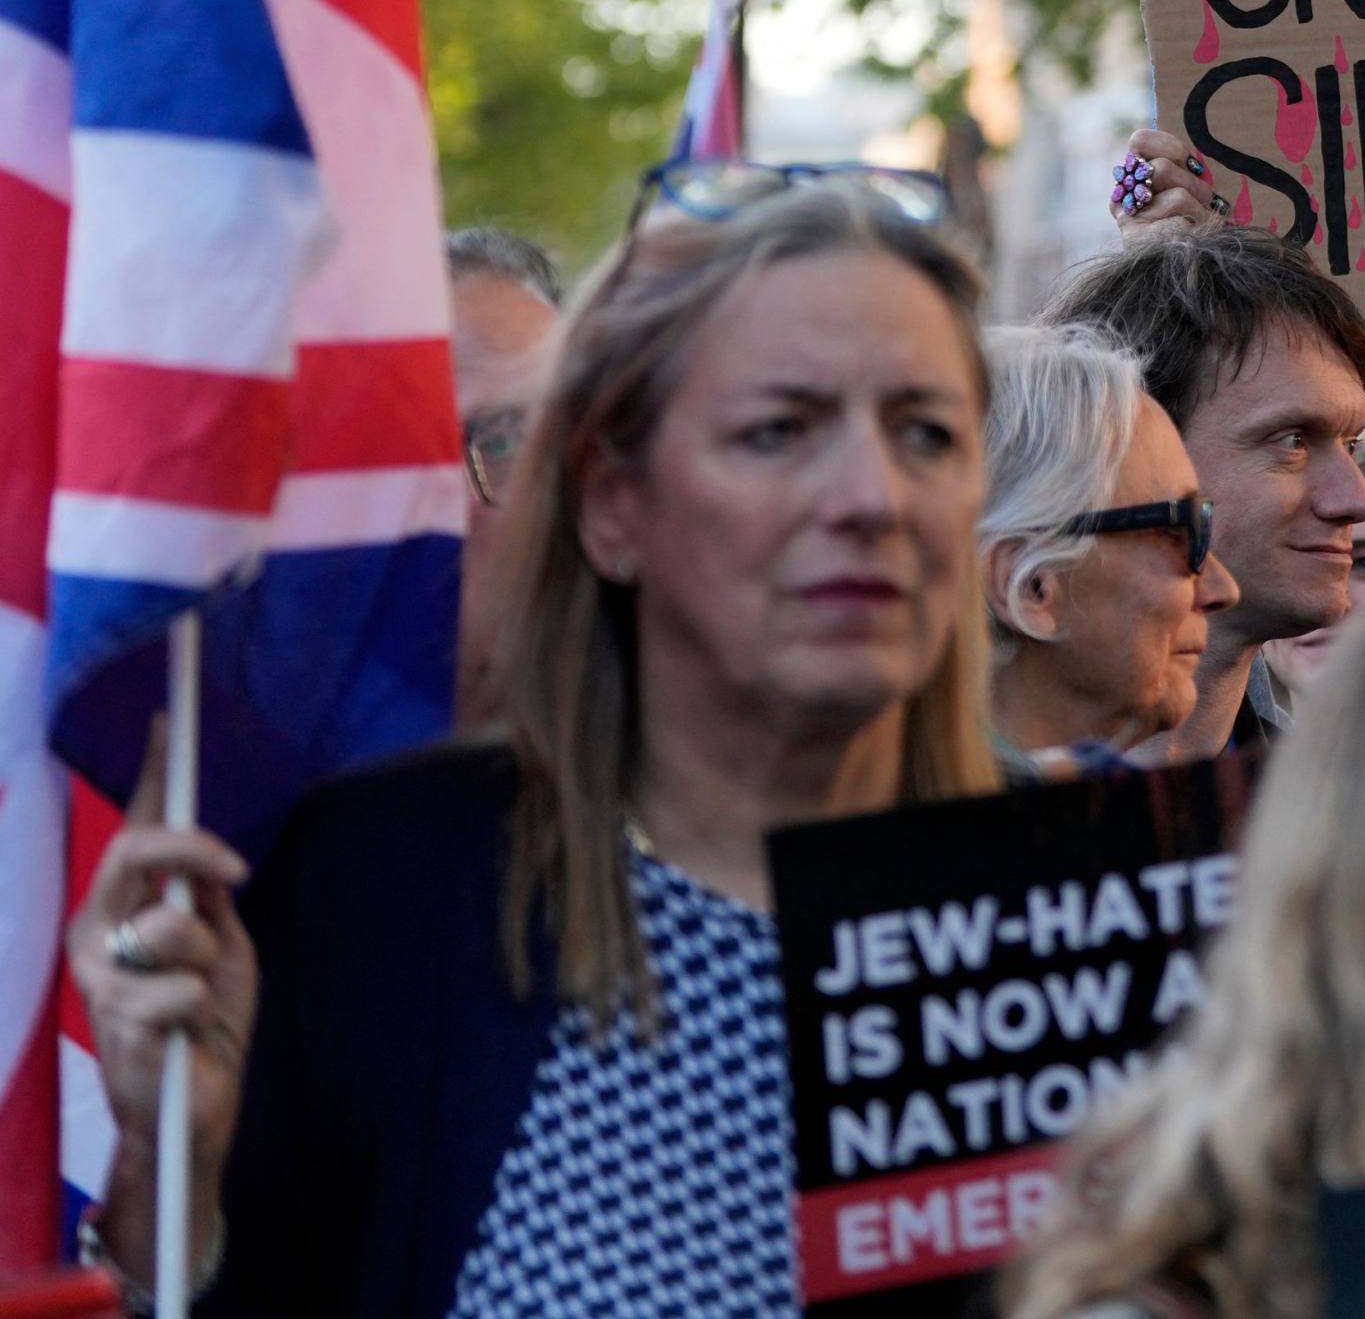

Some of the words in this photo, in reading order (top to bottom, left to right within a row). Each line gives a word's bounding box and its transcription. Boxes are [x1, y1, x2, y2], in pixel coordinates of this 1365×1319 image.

[814, 853, 1240, 996] JEW-HATE
[821, 1005, 903, 1084] IS
[920, 962, 1132, 1066] NOW
